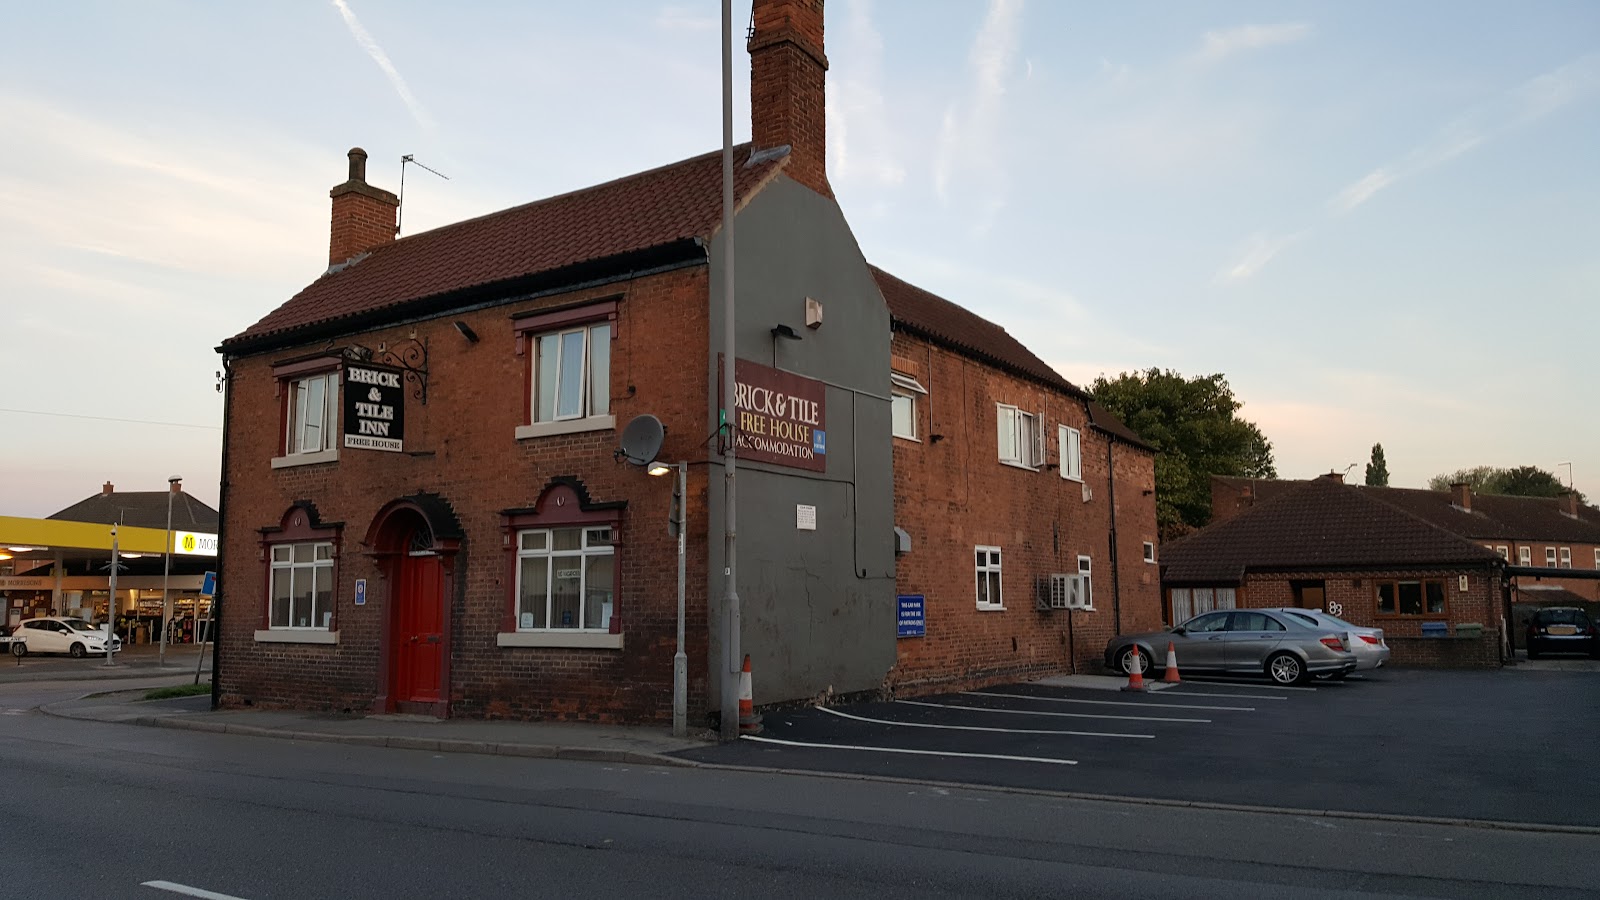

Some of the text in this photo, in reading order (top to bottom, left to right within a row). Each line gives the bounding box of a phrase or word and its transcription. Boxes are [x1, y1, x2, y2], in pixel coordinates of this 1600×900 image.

[348, 367, 401, 388] BRICK
[367, 387, 382, 402] &
[355, 402, 394, 420] TILE
[775, 393, 786, 417] &
[788, 395, 820, 426] TILE
[358, 419, 390, 436] INN
[740, 411, 810, 444] FREE HOUSE
[347, 437, 400, 449] FREE HOUSE
[735, 434, 814, 460] ACCOMMODATION
[1329, 601, 1342, 616] 83
